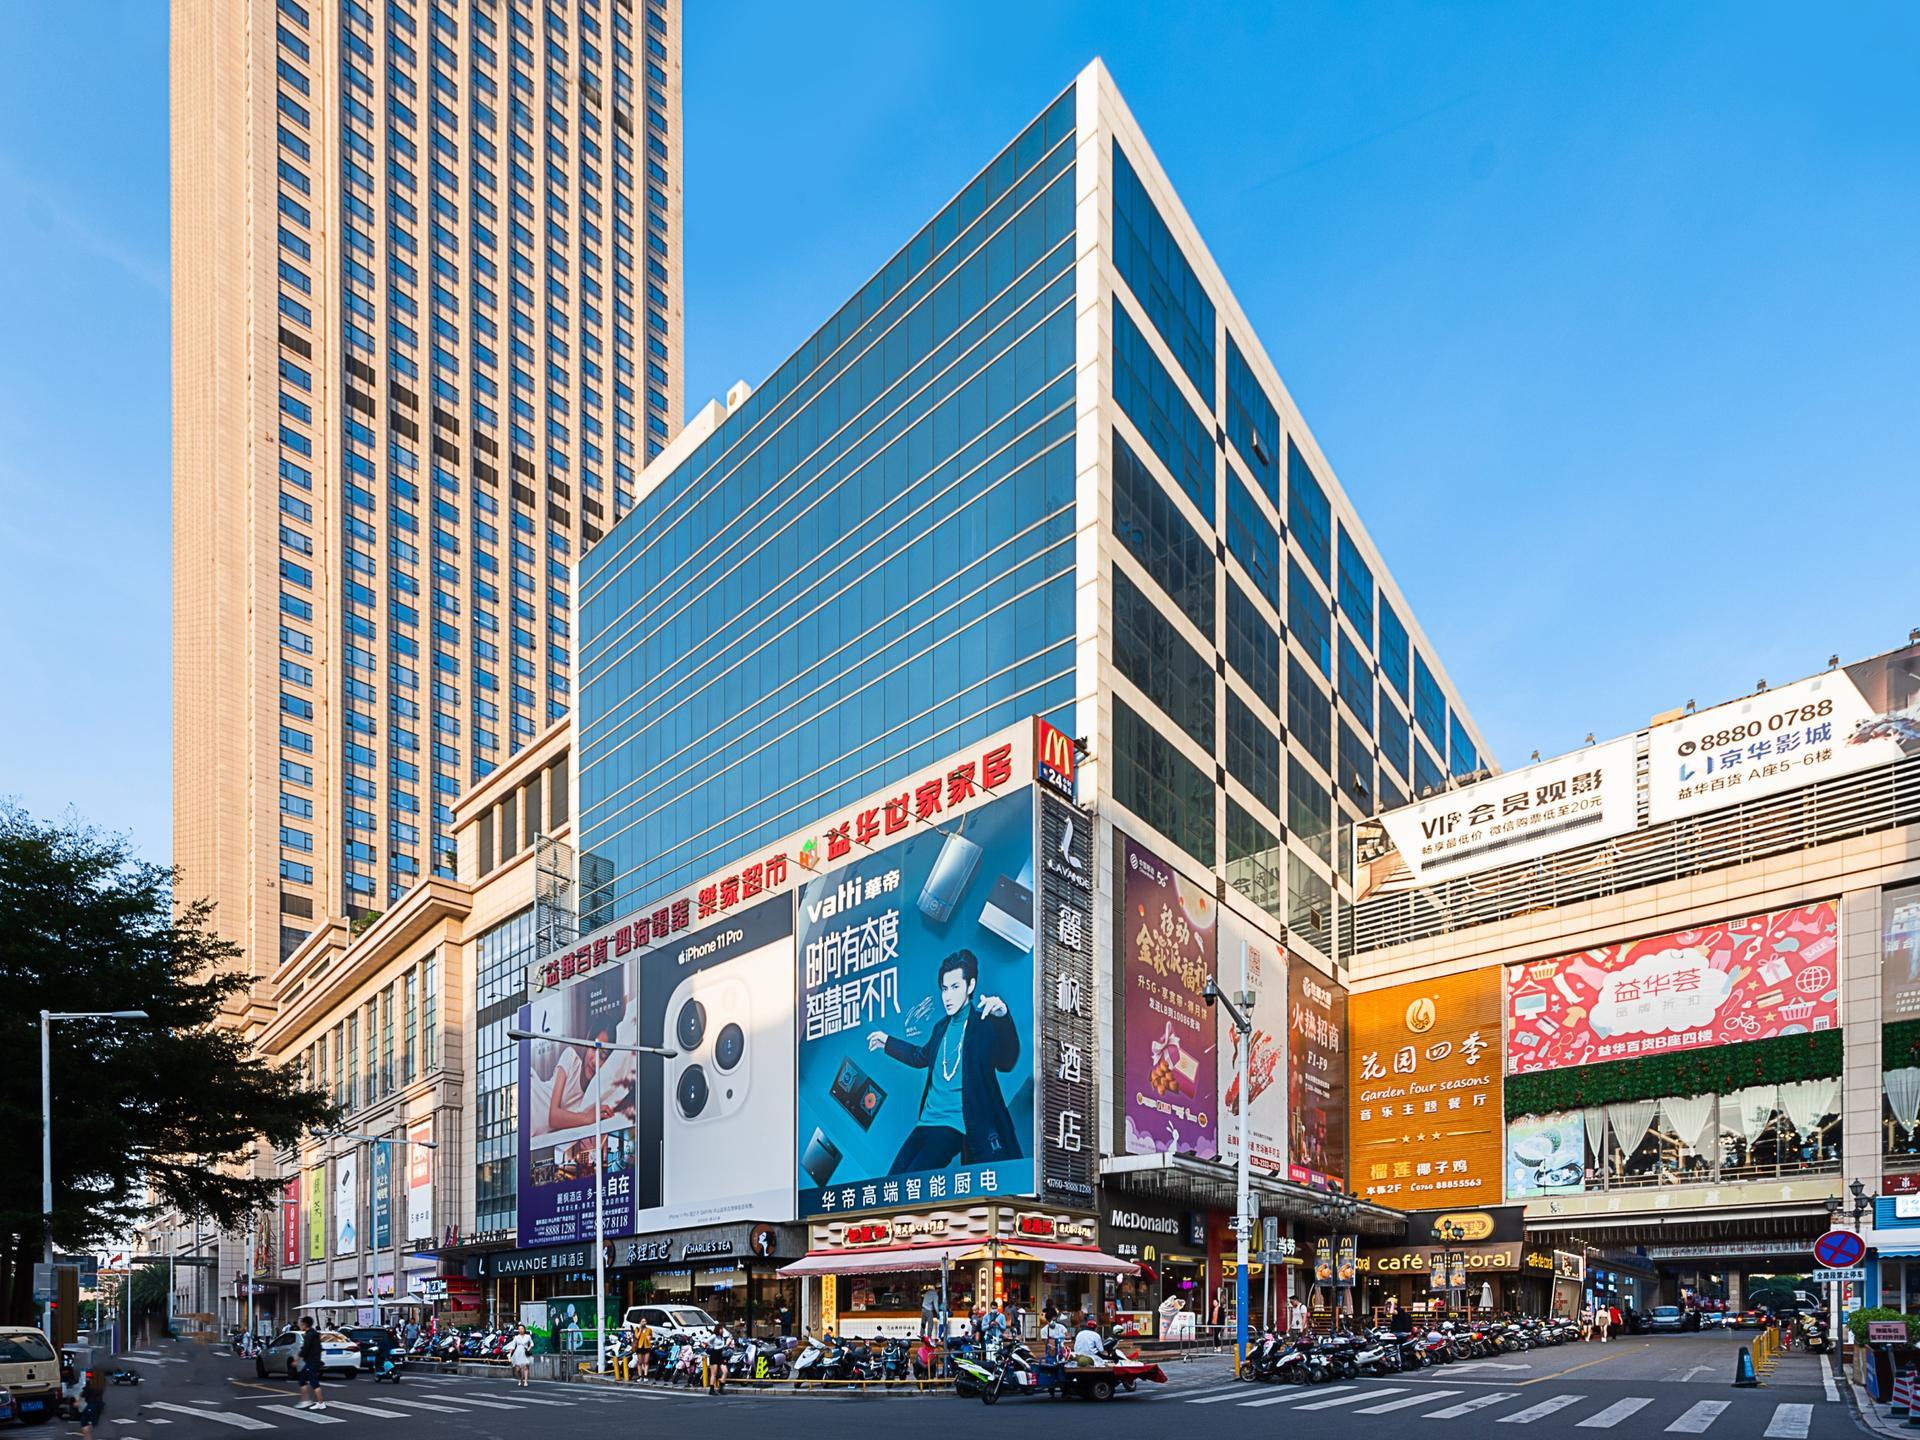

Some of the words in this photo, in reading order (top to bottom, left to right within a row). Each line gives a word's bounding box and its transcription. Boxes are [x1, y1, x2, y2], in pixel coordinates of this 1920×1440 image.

[1700, 720, 1762, 751] 8880
[1768, 699, 1833, 731] 0788
[1720, 722, 1832, 769] 京华影城
[1049, 768, 1063, 789] 24
[1678, 773, 1742, 800] 益华百货
[828, 743, 1012, 861] 益华世家家居
[1422, 830, 1482, 855] 畅享最低价
[864, 869, 900, 900] 華帝
[1048, 859, 1090, 890] LAVANDE
[546, 936, 608, 988] 益華百貨
[615, 897, 690, 957] 四海電器
[698, 853, 787, 920] 樂家超市
[685, 940, 716, 962] iPhone
[716, 933, 725, 949] 11
[727, 929, 743, 946] Pro
[806, 909, 899, 989] 时尚有态度
[1615, 967, 1702, 1004] 益华荟
[806, 966, 901, 1042] 智慧显不凡
[1616, 994, 1700, 1019] 品牌折扣
[1292, 1002, 1339, 1054] 火热招商
[1597, 1028, 1713, 1057] 益华百货B座四楼
[1360, 1031, 1488, 1080] 花园四季
[1360, 1084, 1405, 1102] Garden
[1409, 1081, 1436, 1095] four
[1440, 1075, 1490, 1091] seasons
[1360, 1094, 1487, 1121] 音乐主题餐厅
[1370, 1159, 1468, 1181] 榴莲椰子鸡
[1436, 1178, 1482, 1190] 88855563
[821, 1168, 998, 1212] 华帝高端智能厨电
[1111, 1209, 1179, 1234] McDonald's
[1194, 1226, 1204, 1239] 24
[718, 1240, 731, 1251] TEA
[498, 1256, 547, 1273] LAVANDE
[1378, 1251, 1423, 1271] café
